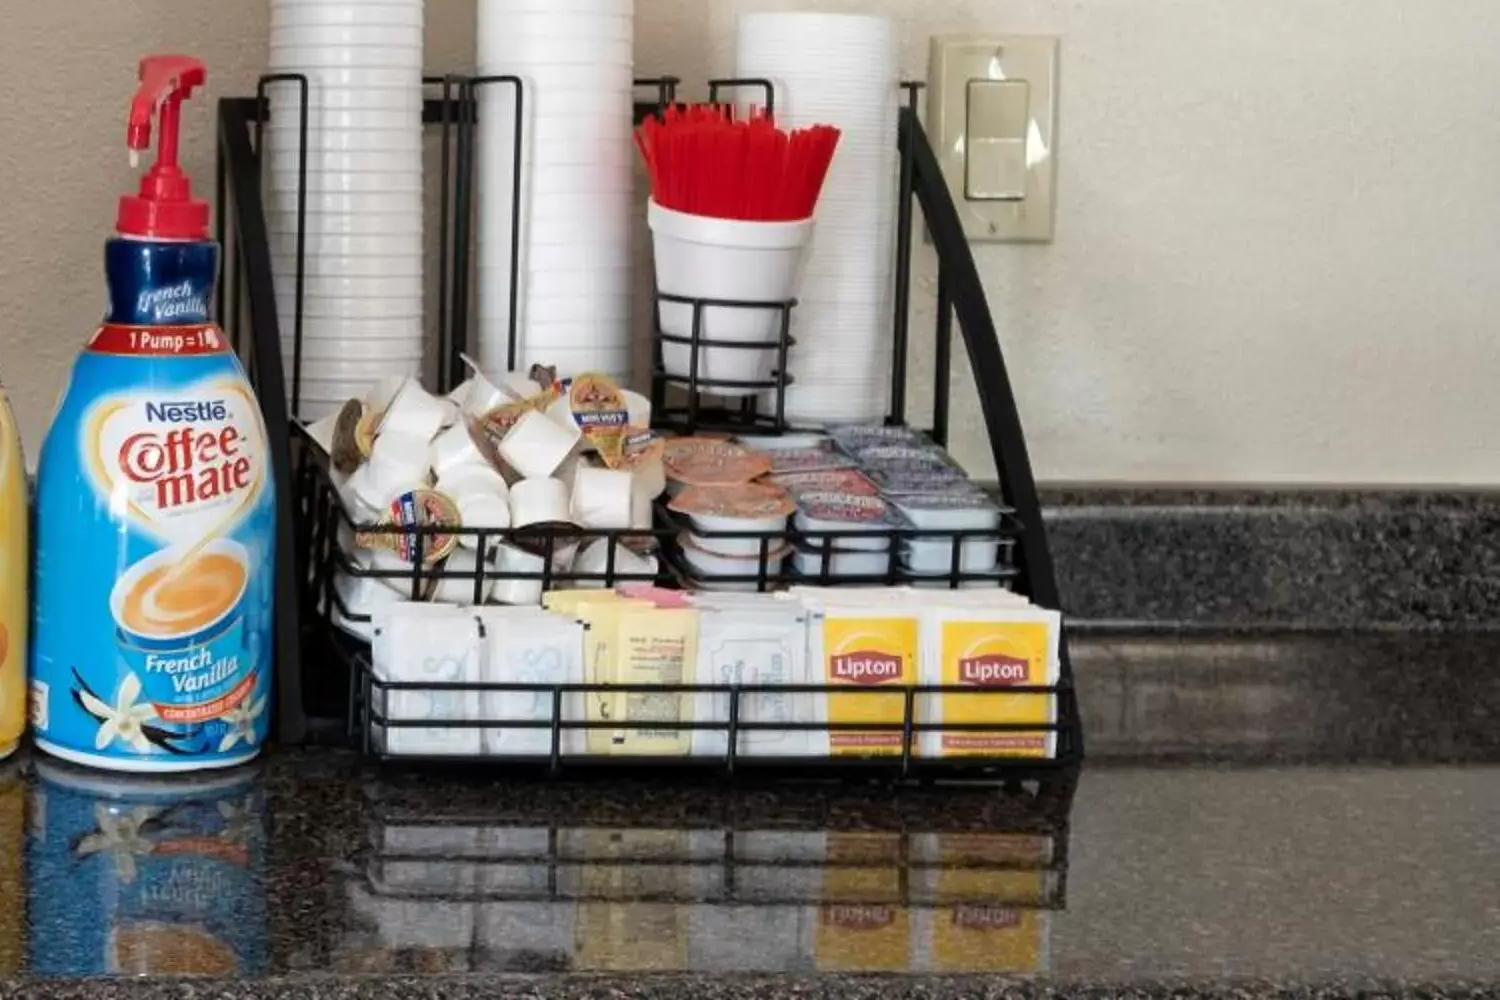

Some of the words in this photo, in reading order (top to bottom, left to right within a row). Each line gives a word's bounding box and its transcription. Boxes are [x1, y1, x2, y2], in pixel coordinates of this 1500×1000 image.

[140, 331, 184, 353] Pump
[156, 457, 250, 509] mate
[145, 648, 212, 673] French
[836, 658, 897, 677] Lipton
[964, 662, 1025, 681] Lipton
[172, 656, 238, 693] Vanilla
